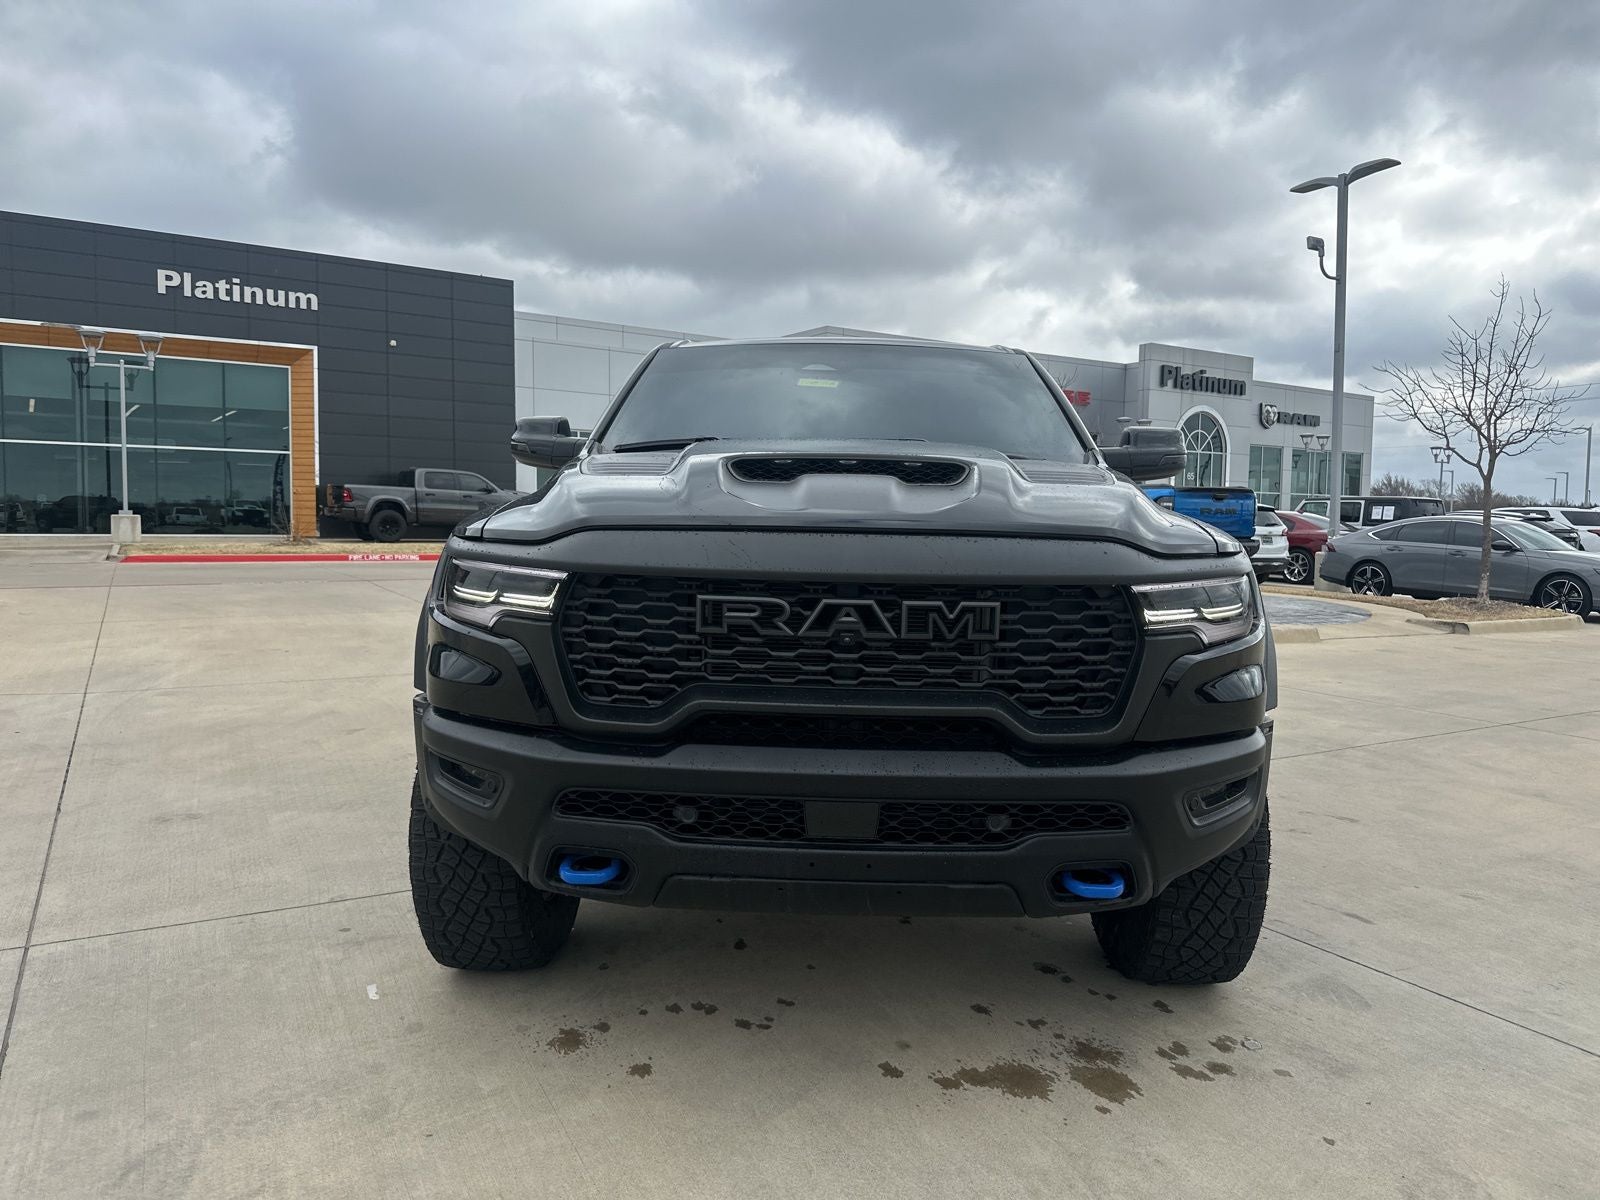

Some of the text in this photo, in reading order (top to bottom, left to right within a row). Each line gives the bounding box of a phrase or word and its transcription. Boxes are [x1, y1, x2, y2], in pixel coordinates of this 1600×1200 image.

[156, 268, 319, 311] Platinum
[1160, 364, 1247, 396] Platinum
[1276, 411, 1321, 427] RAM
[1200, 507, 1238, 516] RAM
[696, 594, 1001, 641] RAM
